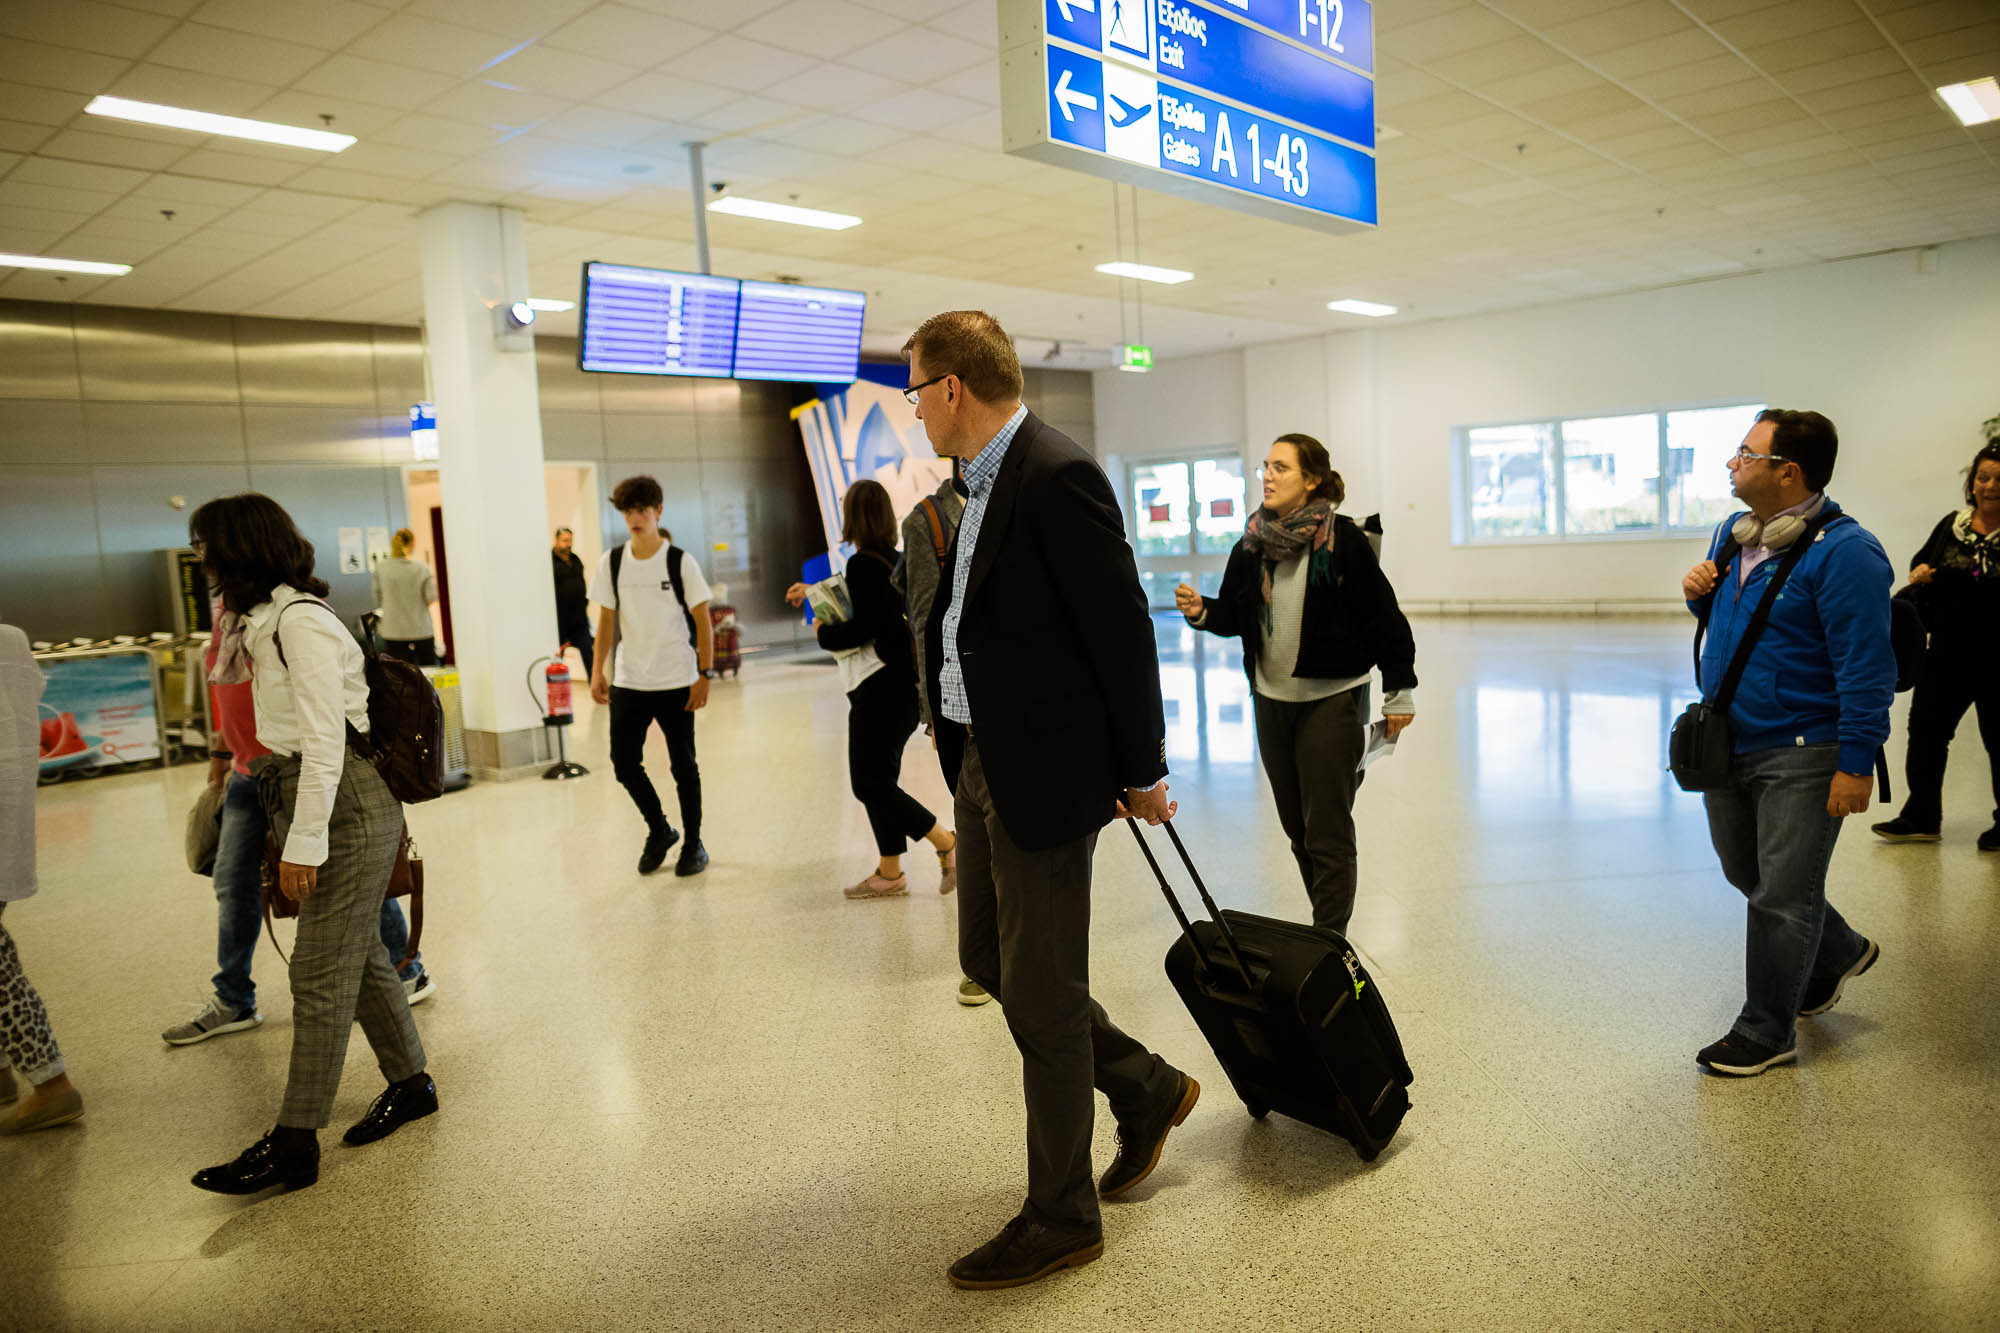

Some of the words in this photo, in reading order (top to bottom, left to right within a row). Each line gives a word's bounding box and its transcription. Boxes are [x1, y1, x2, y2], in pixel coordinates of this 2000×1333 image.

[1159, 34, 1185, 70] Exit
[1162, 132, 1201, 168] Gates
[1211, 111, 1239, 178] A
[1246, 123, 1310, 198] 1-43
